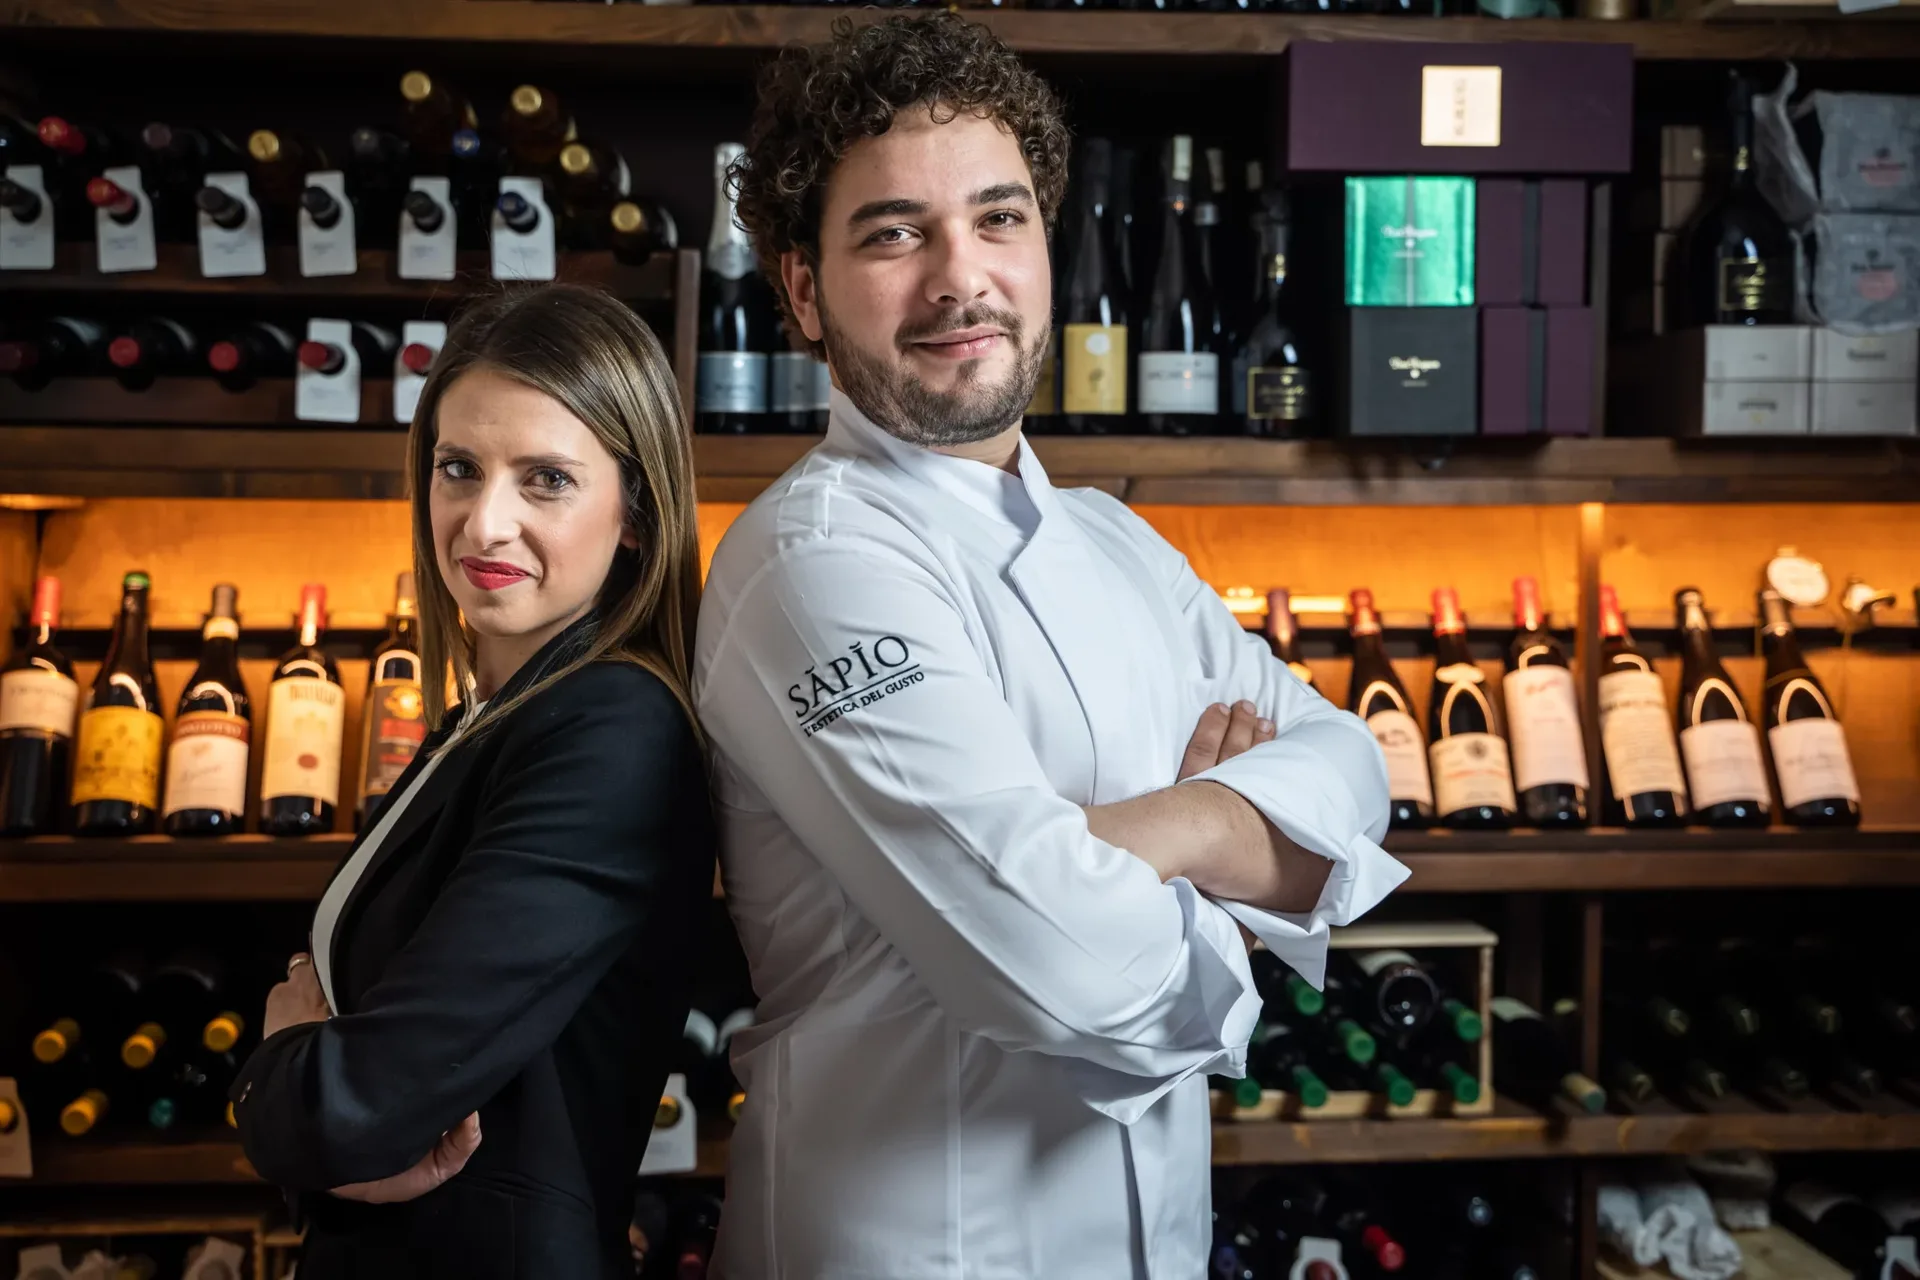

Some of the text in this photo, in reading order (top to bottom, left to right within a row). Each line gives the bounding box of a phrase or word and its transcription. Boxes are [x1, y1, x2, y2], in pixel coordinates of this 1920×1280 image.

[804, 671, 925, 738] L'ESTETICA DEL GUSTO
